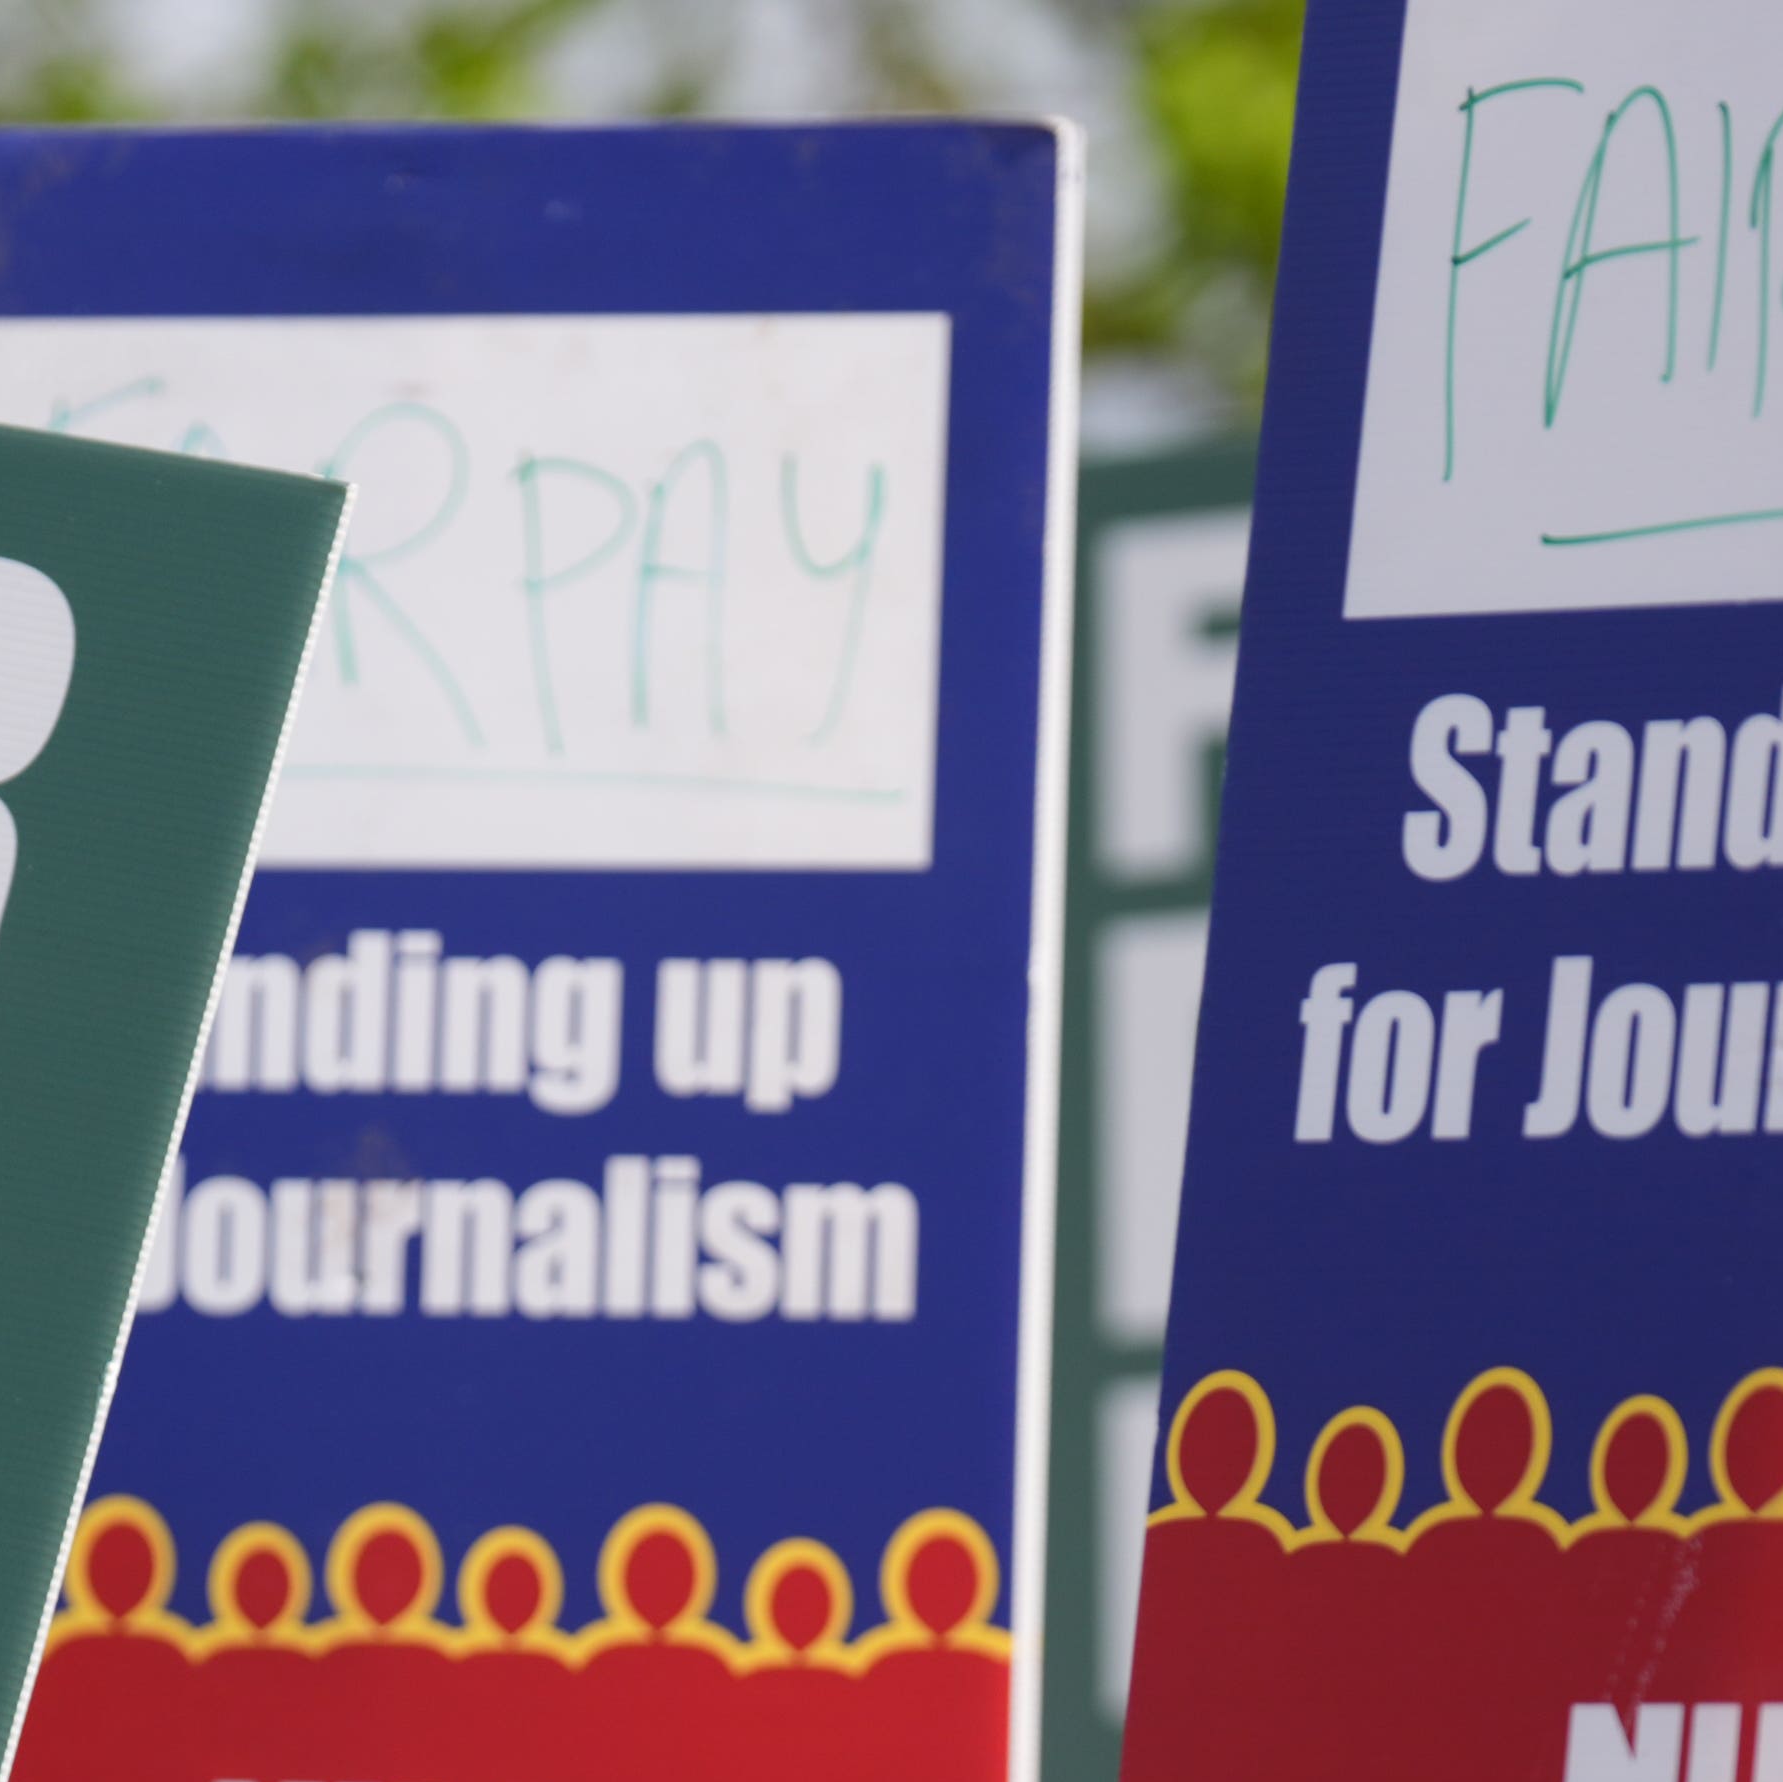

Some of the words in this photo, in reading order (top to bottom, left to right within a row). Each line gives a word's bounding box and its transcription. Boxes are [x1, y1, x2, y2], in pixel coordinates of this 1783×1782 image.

[509, 437, 887, 756] PAY
[195, 928, 624, 1116] nding
[654, 955, 843, 1114] up
[1294, 961, 1504, 1144] for
